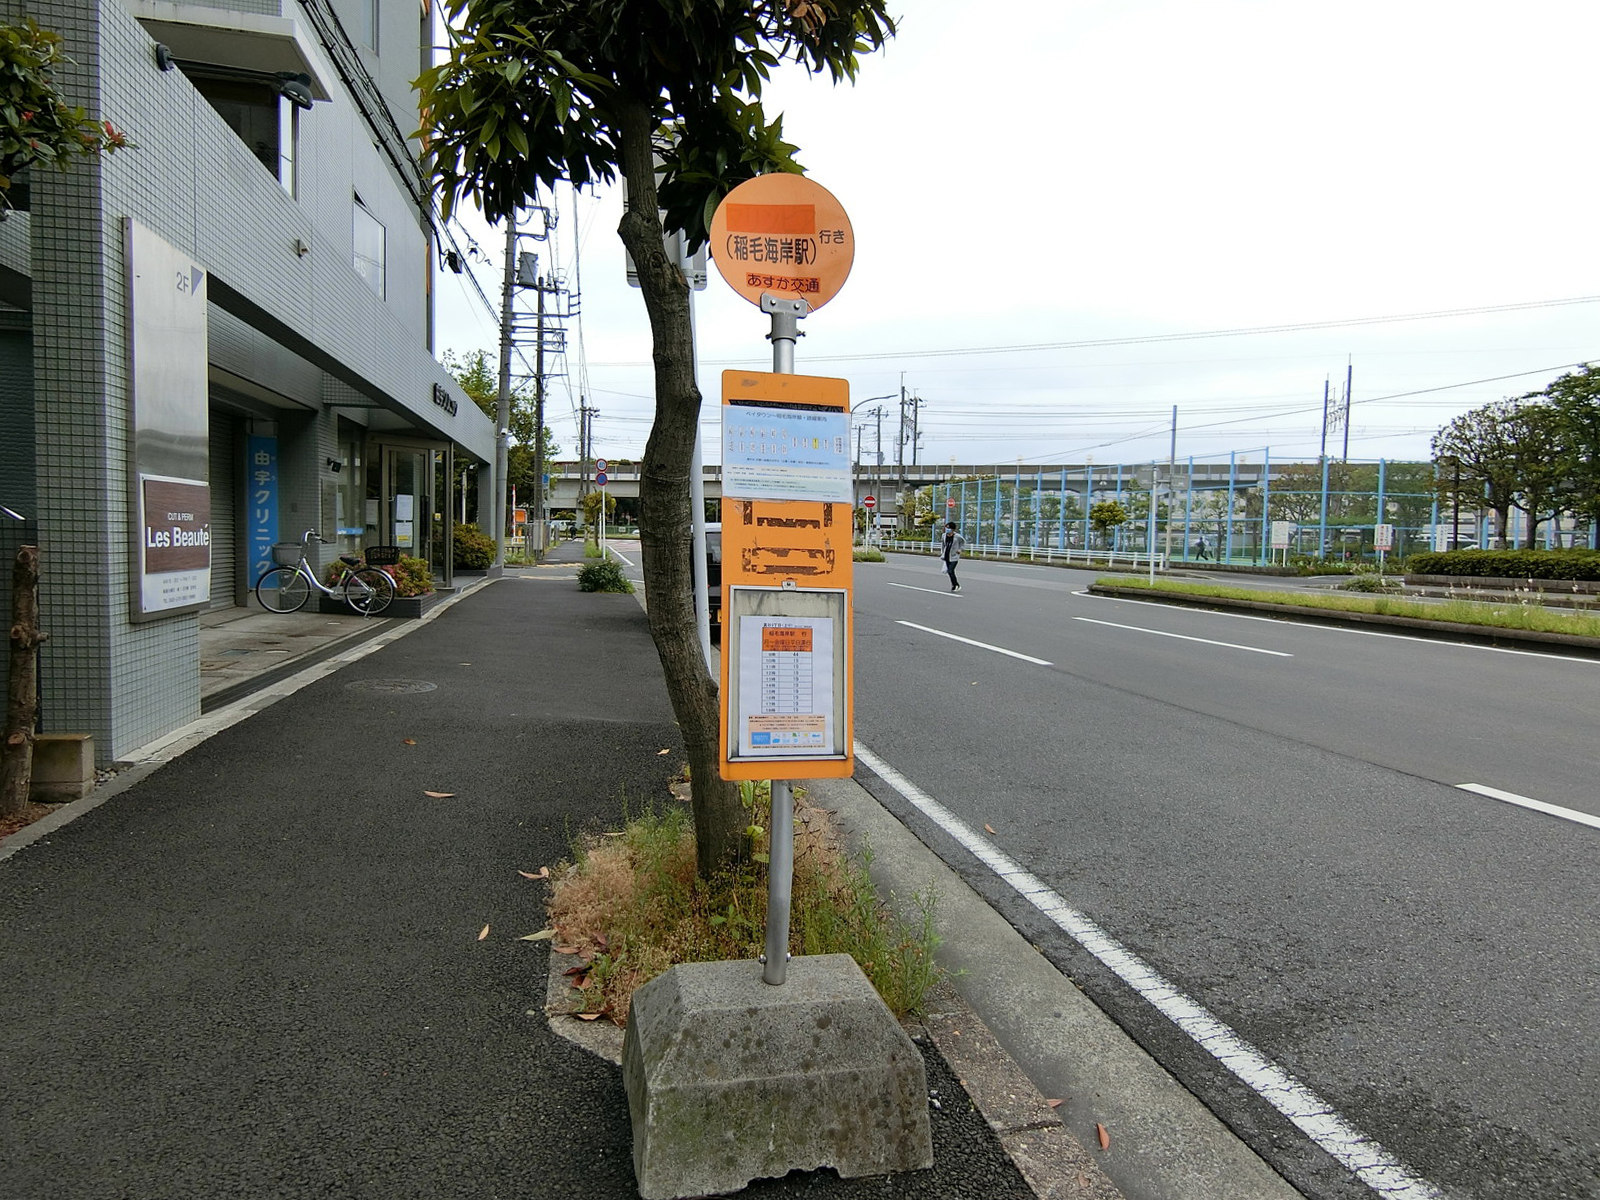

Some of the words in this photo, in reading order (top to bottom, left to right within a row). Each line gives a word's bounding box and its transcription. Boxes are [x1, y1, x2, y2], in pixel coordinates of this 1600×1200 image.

[818, 229, 845, 245] 行き
[176, 271, 190, 294] 2F
[747, 273, 820, 293] あすか交通
[167, 512, 178, 521] CUT
[254, 449, 271, 576] 由宇クリニック
[147, 526, 171, 548] Les
[172, 523, 210, 547] Beauté
